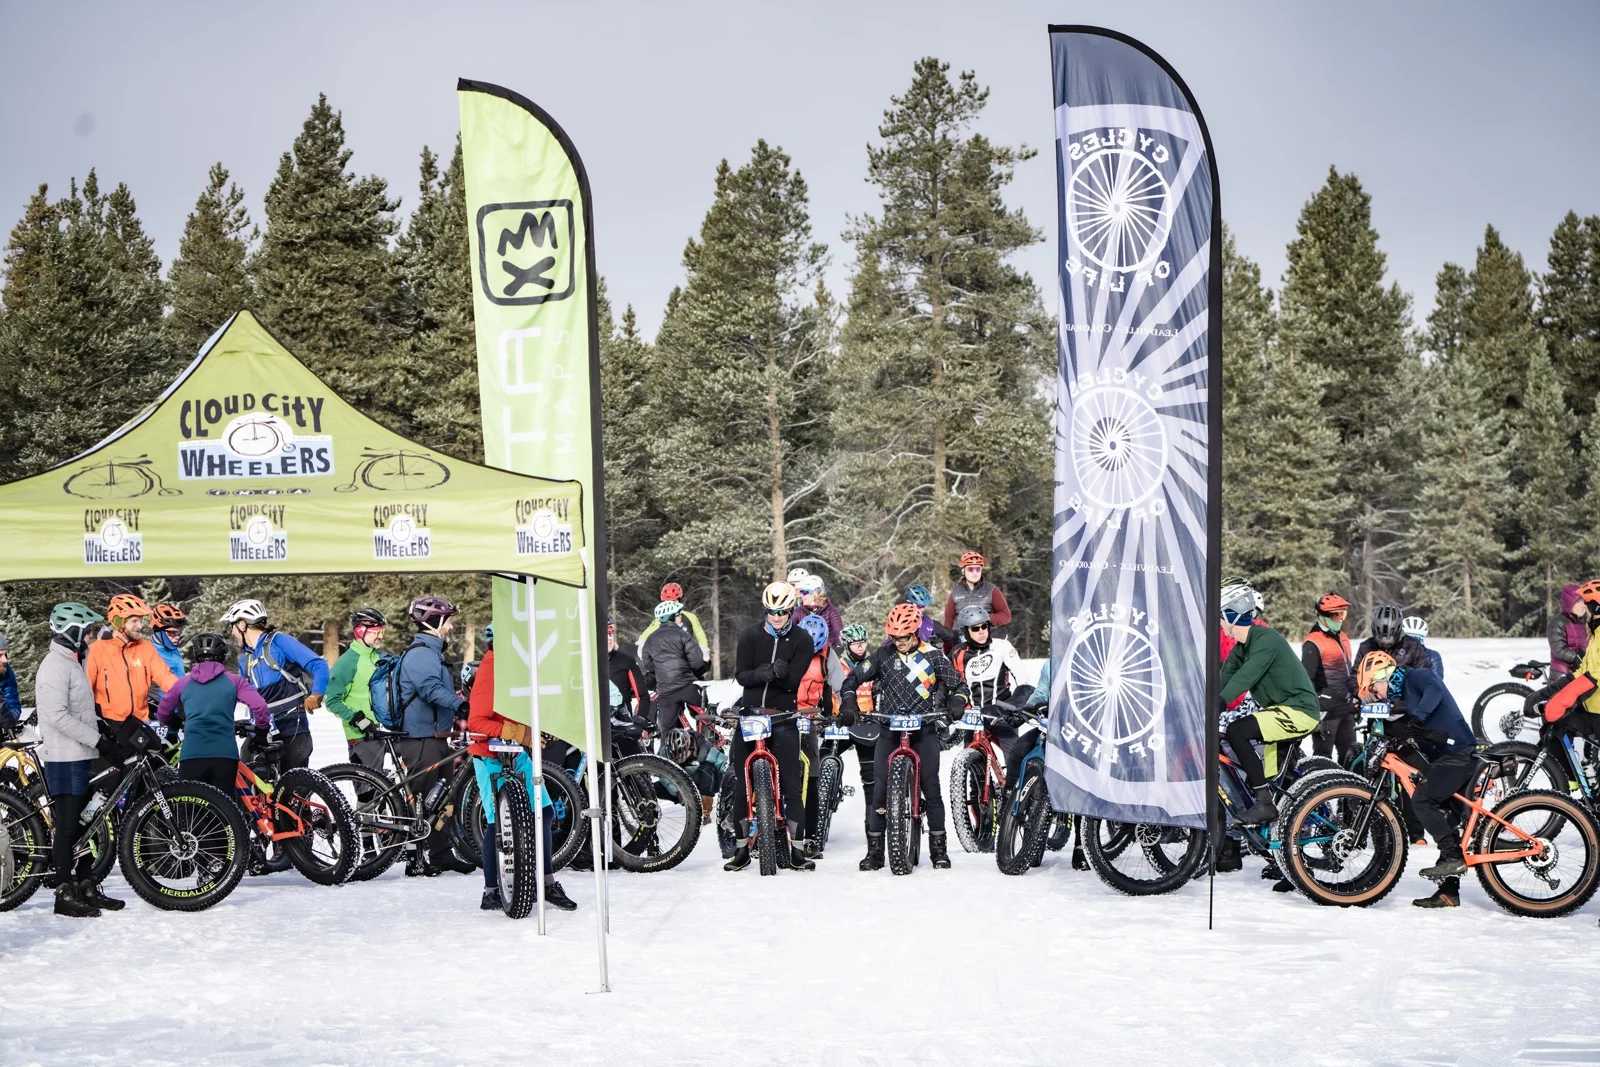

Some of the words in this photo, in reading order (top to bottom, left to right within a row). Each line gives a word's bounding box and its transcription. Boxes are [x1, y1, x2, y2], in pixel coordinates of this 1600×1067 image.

[551, 330, 576, 454] MAPS
[180, 447, 331, 477] WHEELERS
[84, 539, 142, 563] WHEELERS
[230, 537, 287, 560] WHEELERS
[373, 535, 430, 558] WHEELERS
[516, 531, 572, 554] WHEELERS
[155, 727, 168, 738] 659
[901, 720, 919, 728] 649
[550, 829, 576, 862] BONTRAGE
[160, 881, 217, 898] HERBALIFE
